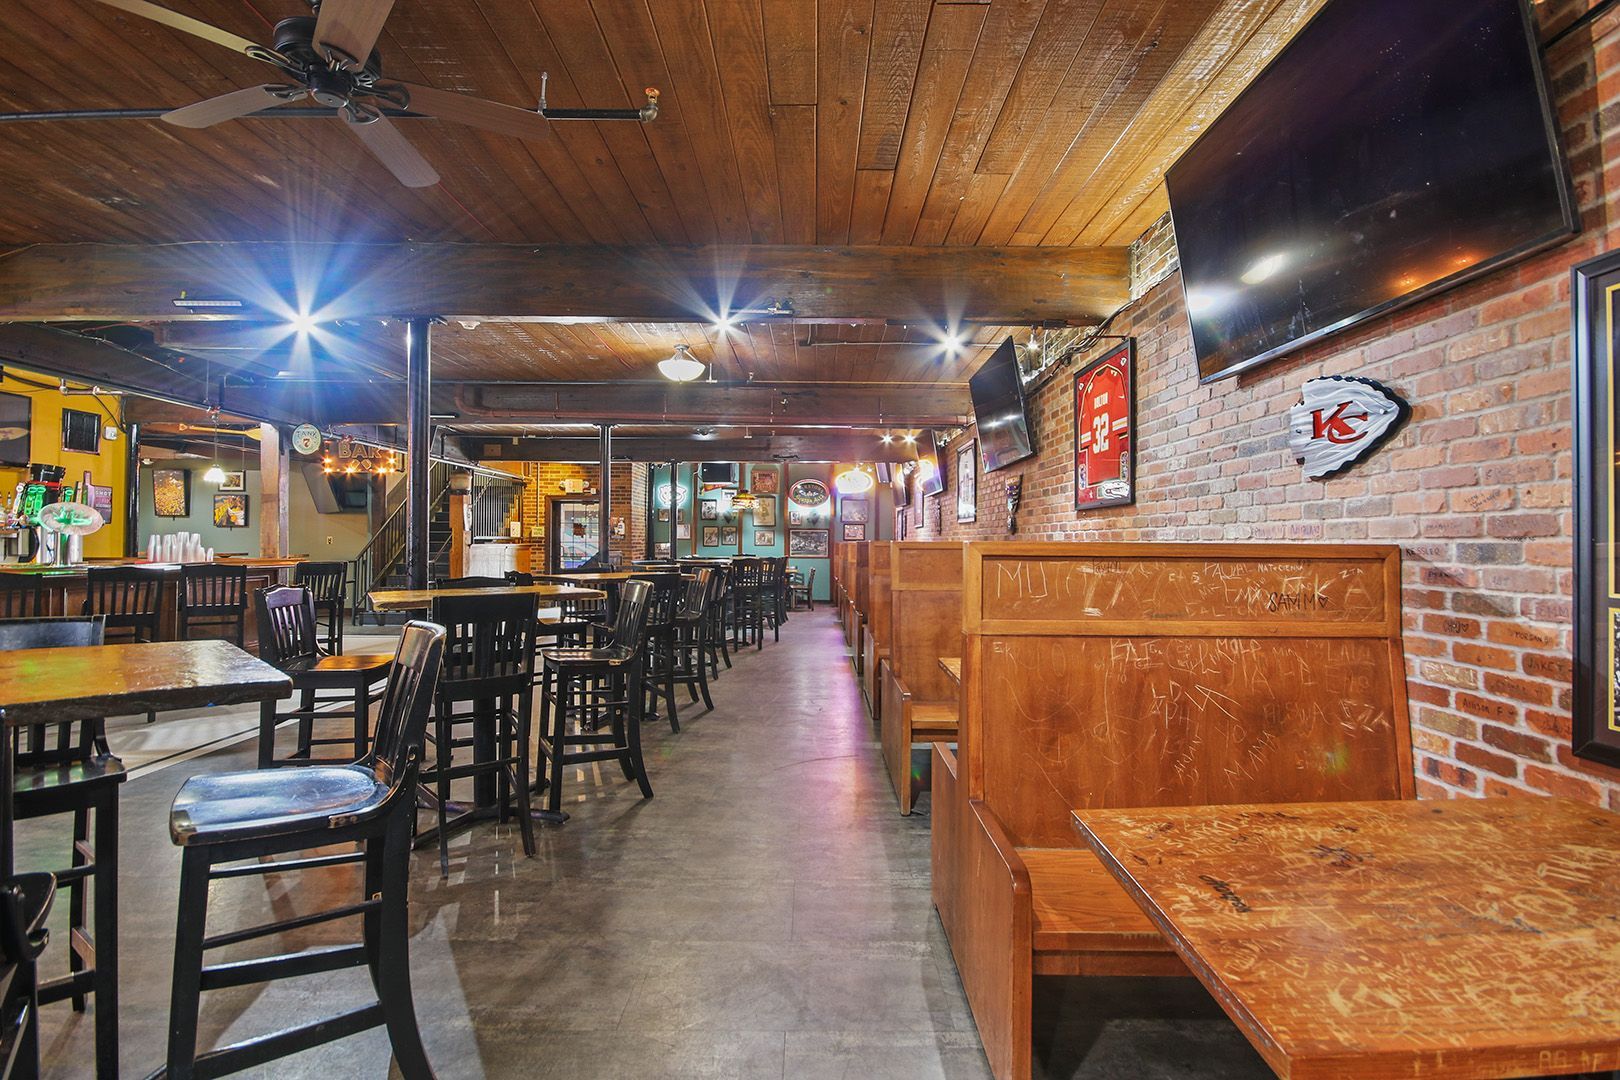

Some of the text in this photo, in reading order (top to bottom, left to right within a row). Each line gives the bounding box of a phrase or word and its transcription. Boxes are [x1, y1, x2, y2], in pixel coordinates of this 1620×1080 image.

[1093, 412, 1109, 454] 32
[1310, 400, 1368, 444] KC
[303, 438, 310, 448] 7
[338, 440, 382, 458] BAR
